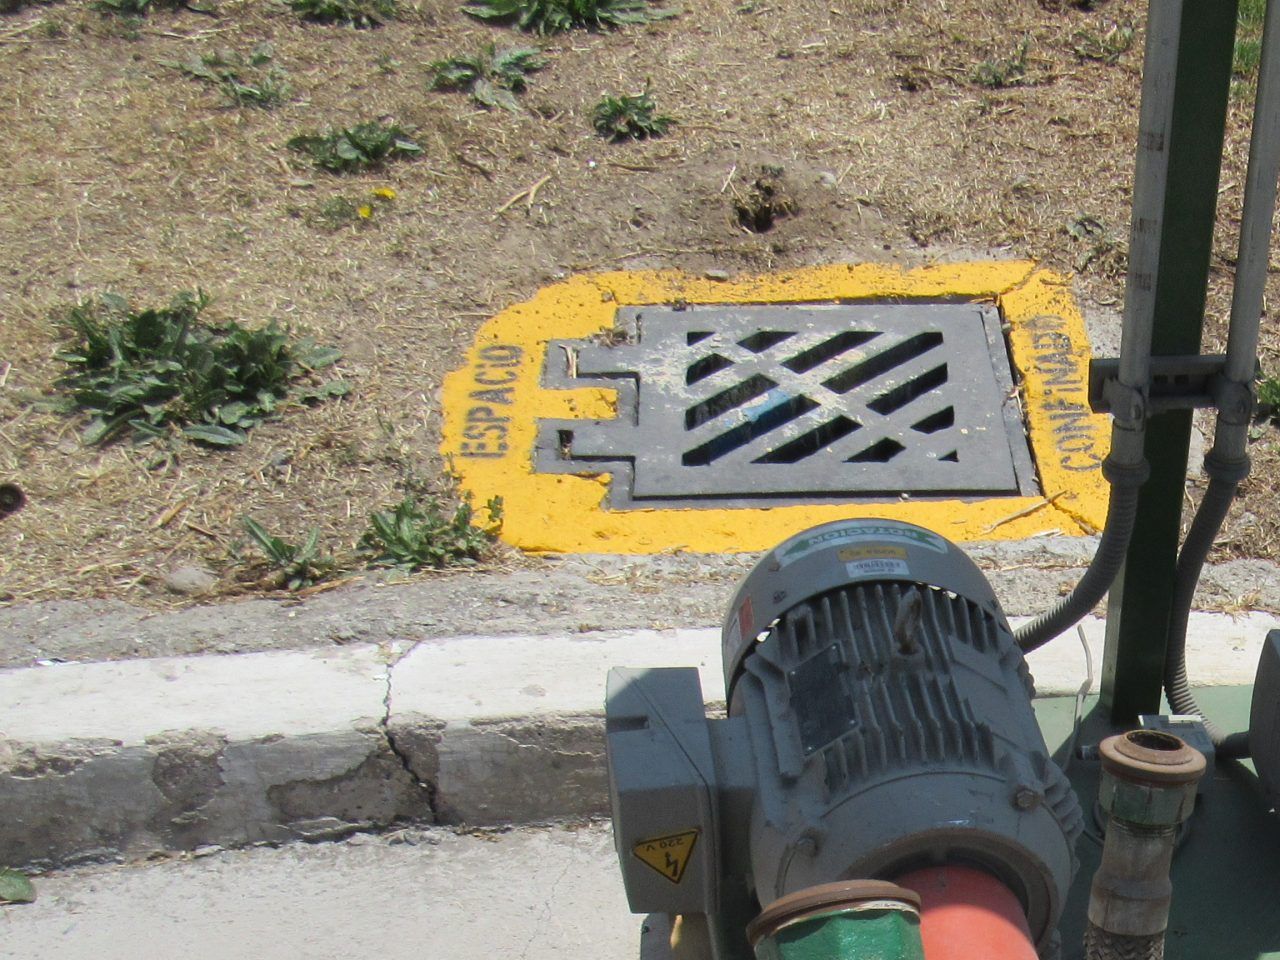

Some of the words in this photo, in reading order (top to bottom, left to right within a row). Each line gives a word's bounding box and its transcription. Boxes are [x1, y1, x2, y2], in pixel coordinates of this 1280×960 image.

[460, 345, 524, 458] ESPACIO
[1025, 314, 1101, 473] CONFINADO
[809, 527, 917, 546] ROTACION
